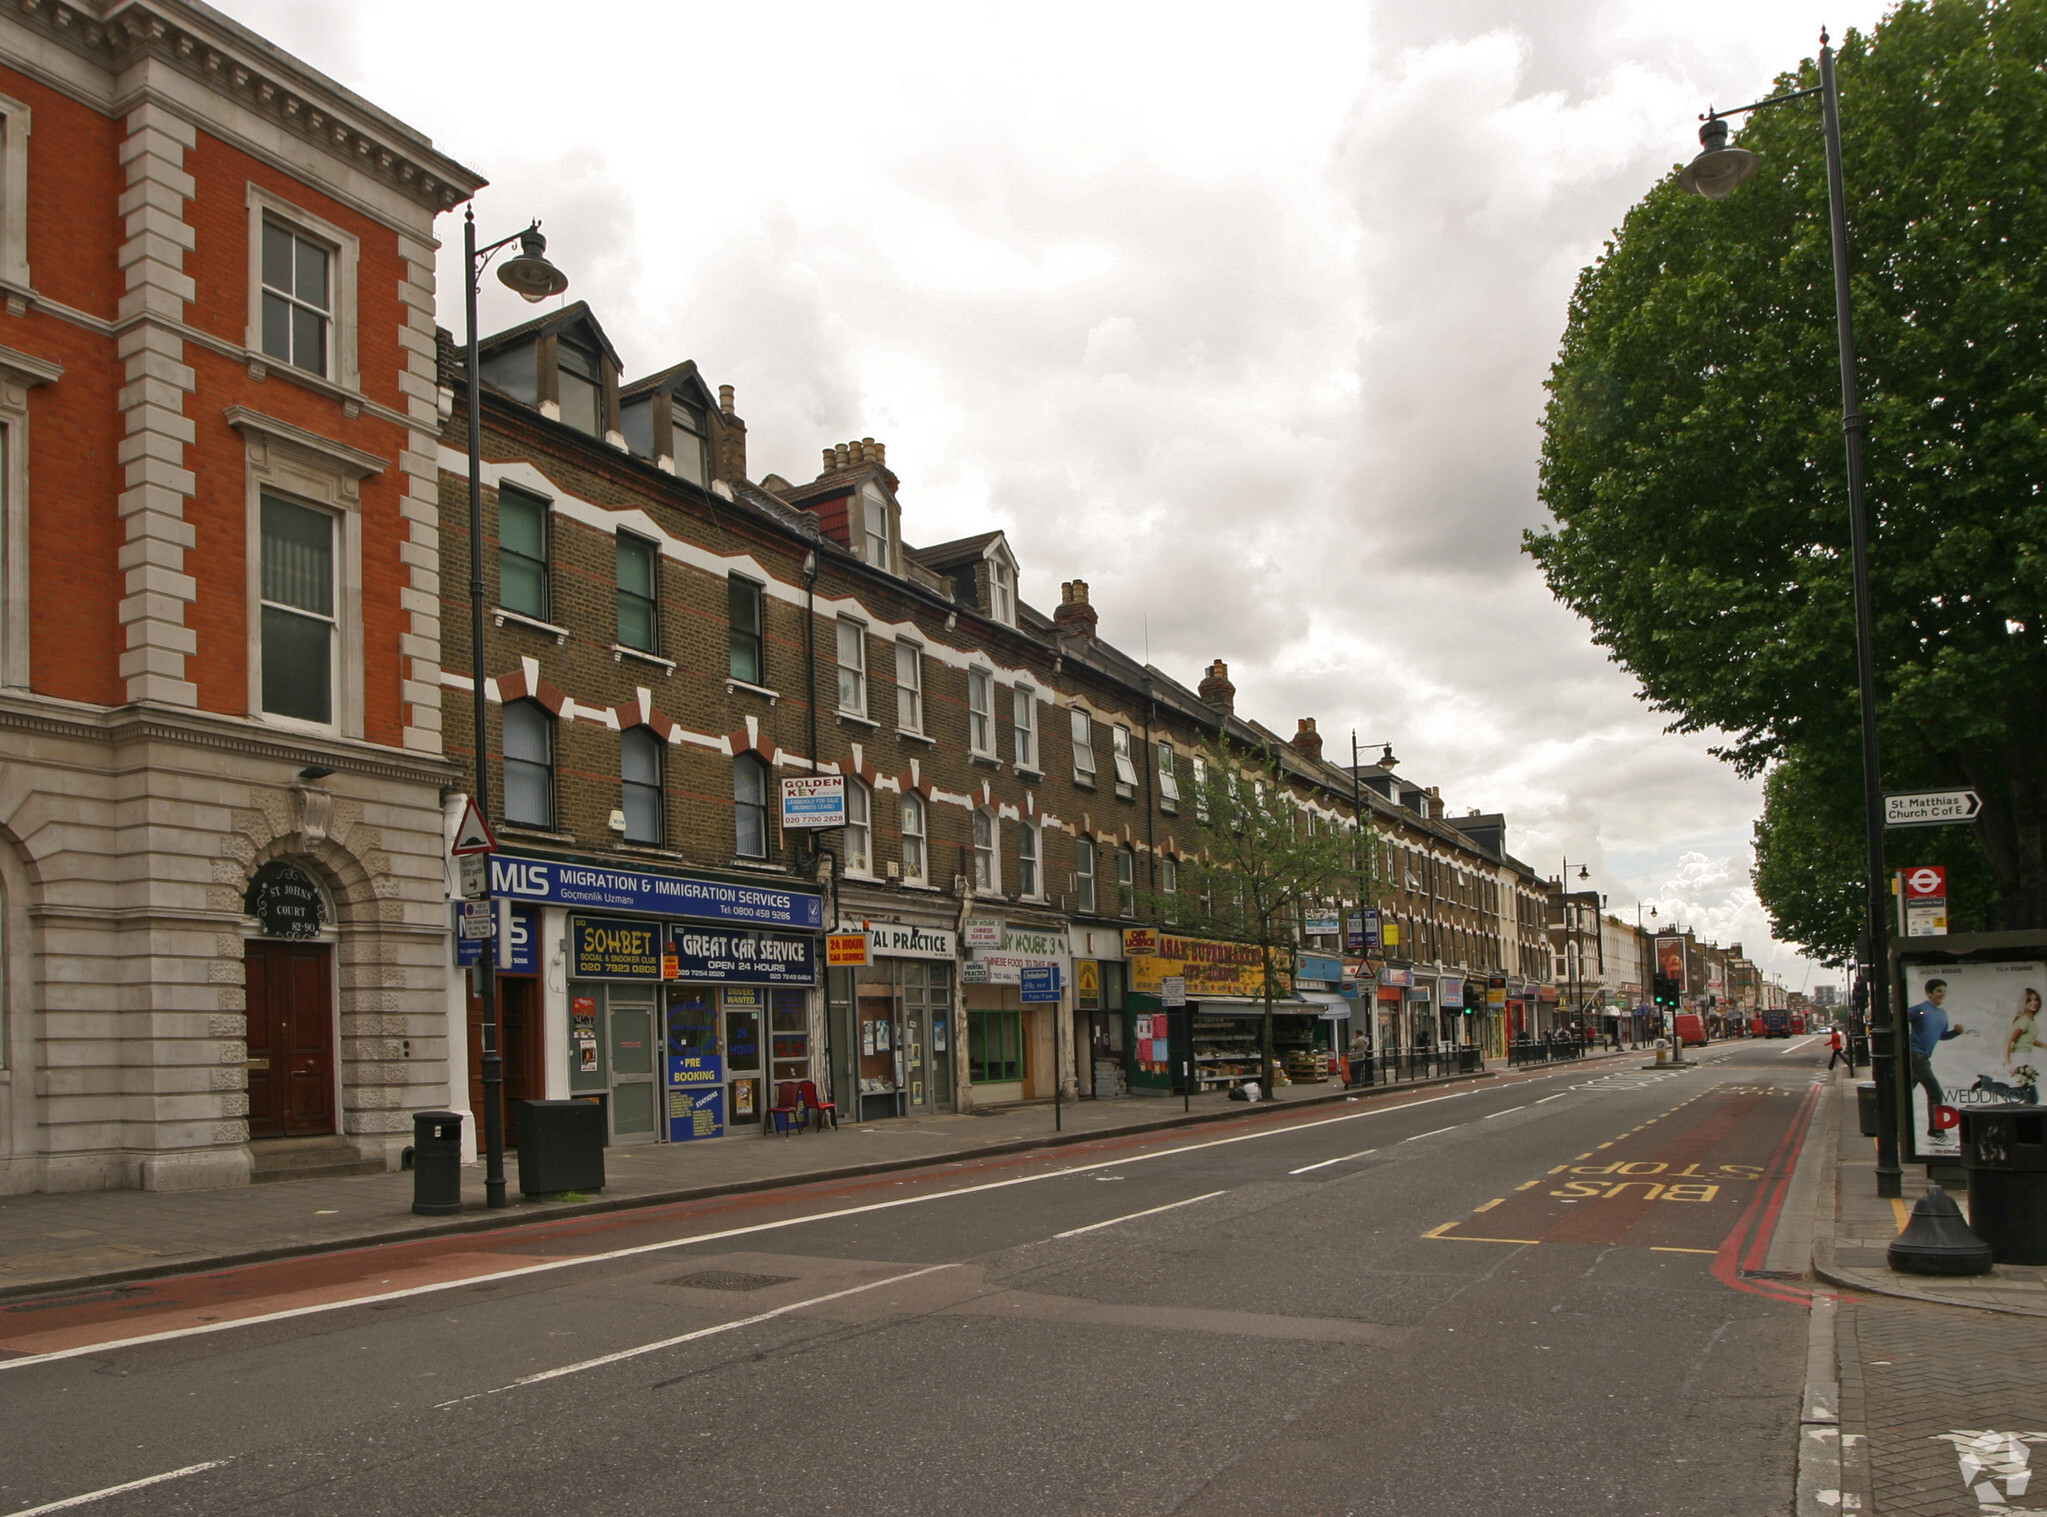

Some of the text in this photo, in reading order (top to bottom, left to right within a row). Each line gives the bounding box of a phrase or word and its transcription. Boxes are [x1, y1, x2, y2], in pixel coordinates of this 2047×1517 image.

[785, 778, 842, 788] GOLDEN
[788, 789, 817, 797] KEY
[1909, 797, 1959, 807] Matthias
[1888, 806, 1962, 819] Church C of E
[491, 860, 550, 896] MIS
[269, 886, 281, 898] ST
[560, 869, 791, 908] MIGRATION & IMMIGRATION SERVICES
[276, 905, 306, 917] COURT
[733, 906, 754, 916] 0800
[755, 909, 770, 918] 458
[1131, 930, 1147, 939] OFF
[584, 927, 652, 955] SOHBET
[830, 938, 864, 950] 24 HOUR
[893, 932, 946, 952] PRACTICE
[1015, 933, 1048, 955] HOUSE
[1049, 936, 1056, 956] 3
[683, 934, 805, 962] GREAT CAR SERVICE
[580, 953, 603, 962] SOCIAL
[610, 955, 640, 963] SNOOKER
[641, 956, 656, 964] CLUB
[842, 952, 865, 961] SERVICE
[580, 963, 601, 971] 020
[605, 963, 630, 972] 7923
[707, 960, 786, 972] OPEN 24 HOURS
[1007, 959, 1023, 968] FOOD
[1025, 959, 1033, 968] TO
[727, 996, 755, 1004] WANTED
[684, 1058, 701, 1067] PRE
[674, 1070, 715, 1082] BOOKING
[695, 1090, 719, 1108] STATIONS
[1567, 1161, 1765, 1180] STOP
[1550, 1181, 1720, 1202] BUS
